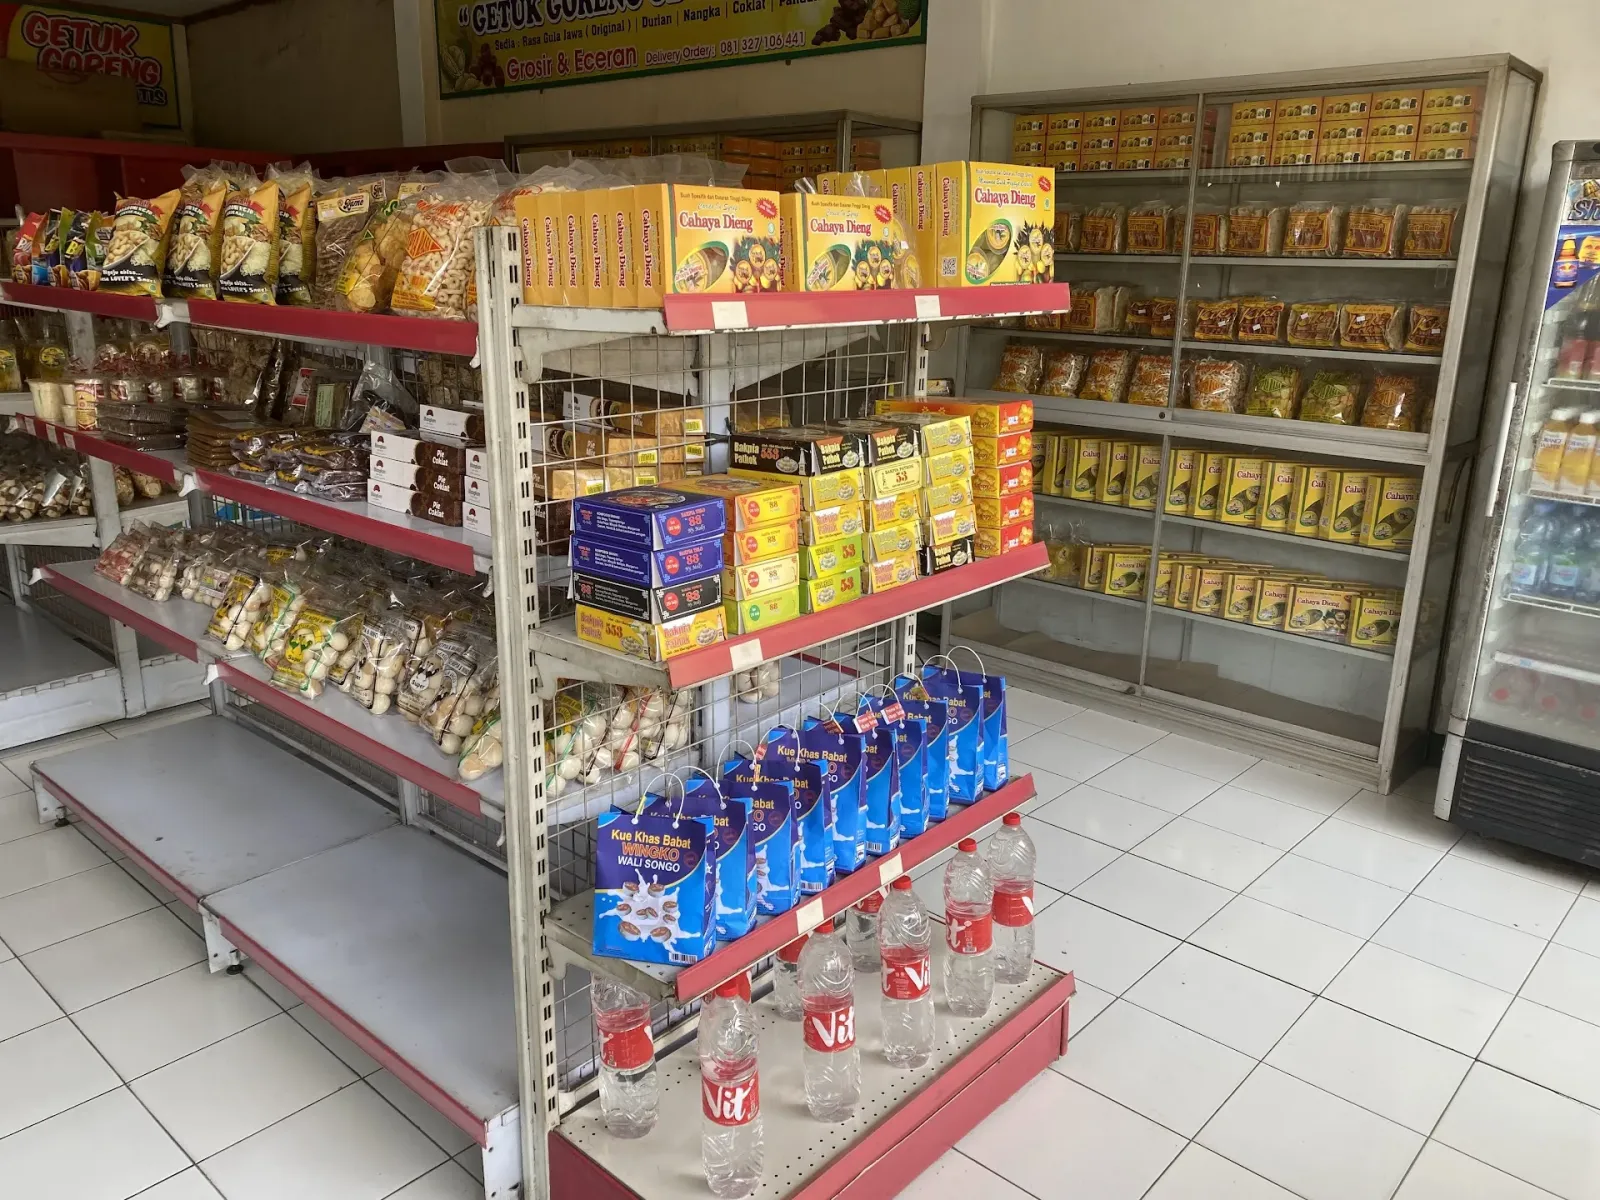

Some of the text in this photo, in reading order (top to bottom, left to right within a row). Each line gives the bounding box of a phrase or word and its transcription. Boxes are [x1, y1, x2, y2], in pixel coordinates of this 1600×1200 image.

[522, 35, 541, 47] Rasa
[543, 33, 561, 44] Gula
[563, 29, 583, 42] Jawa
[641, 15, 672, 29] Durian
[683, 7, 721, 22] Nangka
[733, 0, 766, 14] Coklat
[23, 11, 139, 57] GETUK
[506, 53, 553, 82] Grosir
[557, 52, 570, 74] &
[574, 46, 638, 73] Eceran
[644, 50, 681, 66] Delivery
[719, 39, 739, 54] 081
[783, 31, 806, 47] 441
[38, 47, 161, 87] GORENG
[974, 188, 1036, 208] Cahaya Dieng
[680, 212, 753, 233] Cahaya Dieng
[810, 218, 872, 236] Cahaya Dieng
[522, 217, 530, 257] Cahaya
[544, 216, 552, 256] Cahaya
[567, 214, 578, 288] Cahaya Dieng
[592, 213, 602, 288] Cahaya Dieng
[616, 211, 627, 288] Cahaya Dieng
[642, 208, 653, 288] Cahaya Dieng
[587, 440, 596, 449] Pie
[876, 434, 896, 447] Bakpia
[436, 450, 444, 458] Pie
[734, 442, 760, 454] Bakpia
[821, 444, 840, 454] Bakpia
[878, 444, 896, 457] Pathok
[432, 456, 448, 466] Coklat
[734, 453, 758, 466] Pathok
[822, 454, 840, 465] Pathok
[1115, 453, 1128, 461] Cah
[1142, 456, 1160, 466] Caha
[1178, 462, 1193, 470] Cah
[1208, 466, 1223, 474] Cah
[437, 475, 446, 484] Pie
[1276, 475, 1294, 484] Cah
[1311, 480, 1326, 488] Cah
[434, 482, 450, 492] Coklat
[432, 501, 441, 510] Pie
[428, 508, 444, 518] Coklat
[768, 536, 776, 544] 88
[842, 544, 856, 559] 53
[1115, 562, 1135, 570] Cahaya
[769, 570, 778, 578] 88
[840, 576, 854, 592] 53
[1296, 598, 1340, 608] Cahaya Dieng
[1363, 607, 1401, 617] Cahaya Die
[412, 680, 426, 689] Super
[778, 745, 795, 756] Kue
[799, 746, 820, 760] Khas
[822, 750, 848, 763] Babat
[754, 798, 774, 810] abat
[612, 829, 691, 850] Kue Khas Babat
[622, 842, 680, 862] WINGKO
[618, 856, 680, 873] WALI SONGO
[812, 1006, 855, 1048] Vit
[703, 1080, 750, 1121] Vit
